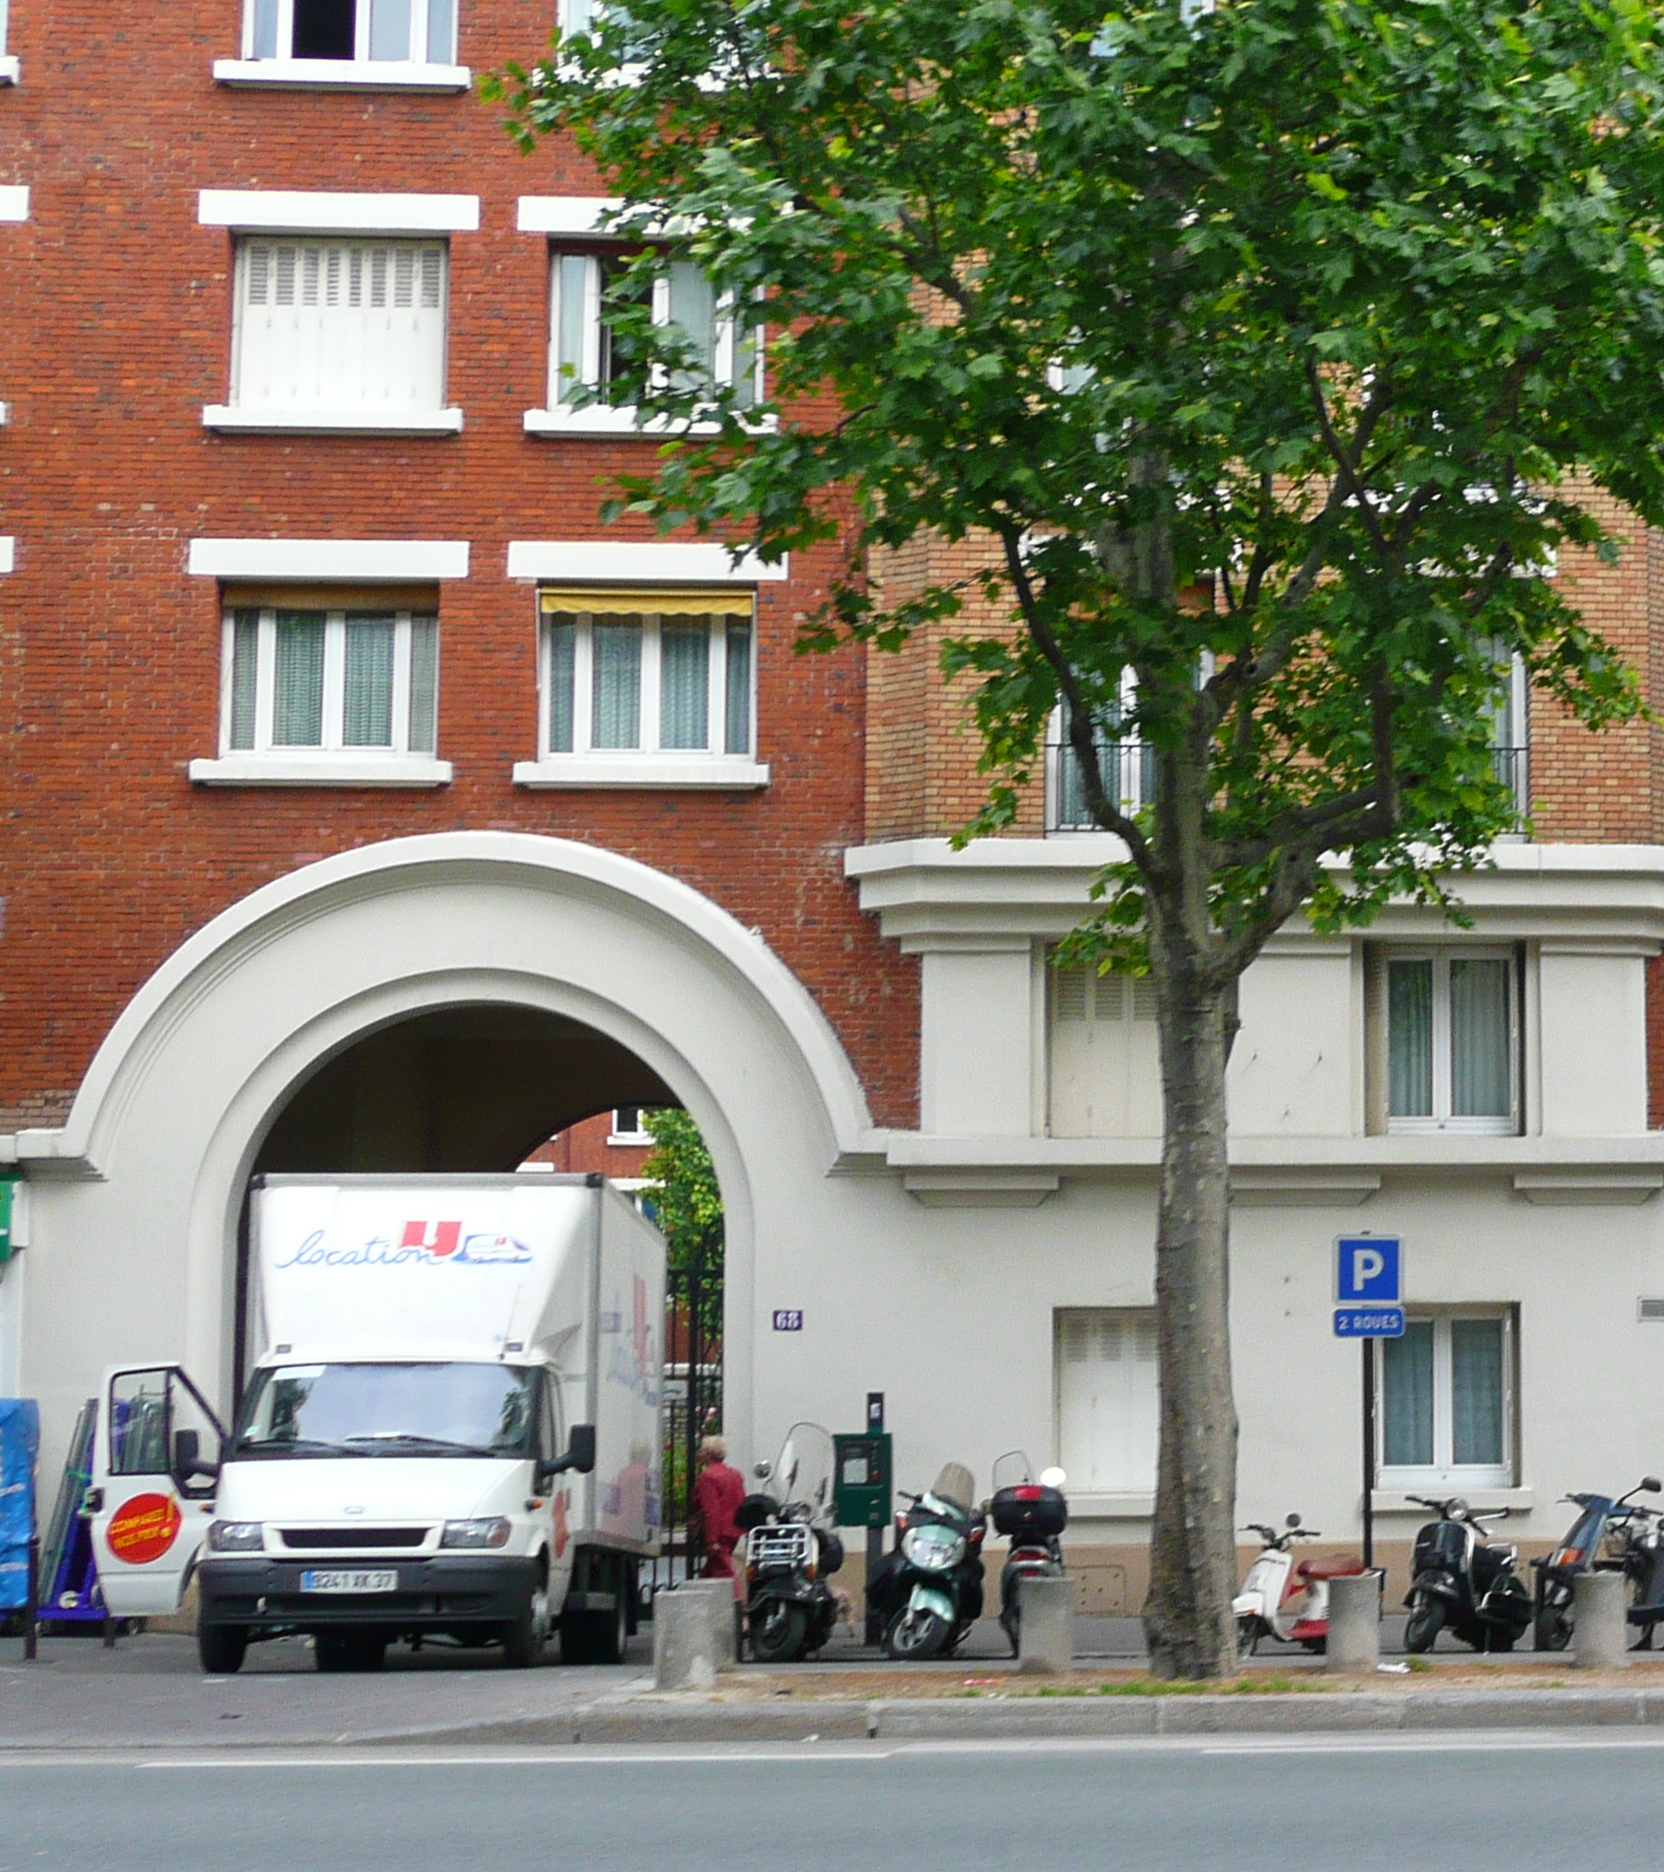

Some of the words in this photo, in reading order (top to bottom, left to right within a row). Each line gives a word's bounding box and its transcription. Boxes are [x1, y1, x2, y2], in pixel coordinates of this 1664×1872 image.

[275, 1229, 444, 1269] location
[1353, 1249, 1384, 1291] P
[776, 1312, 799, 1330] 68
[1338, 1316, 1350, 1330] 2
[1353, 1315, 1399, 1329] ROUES
